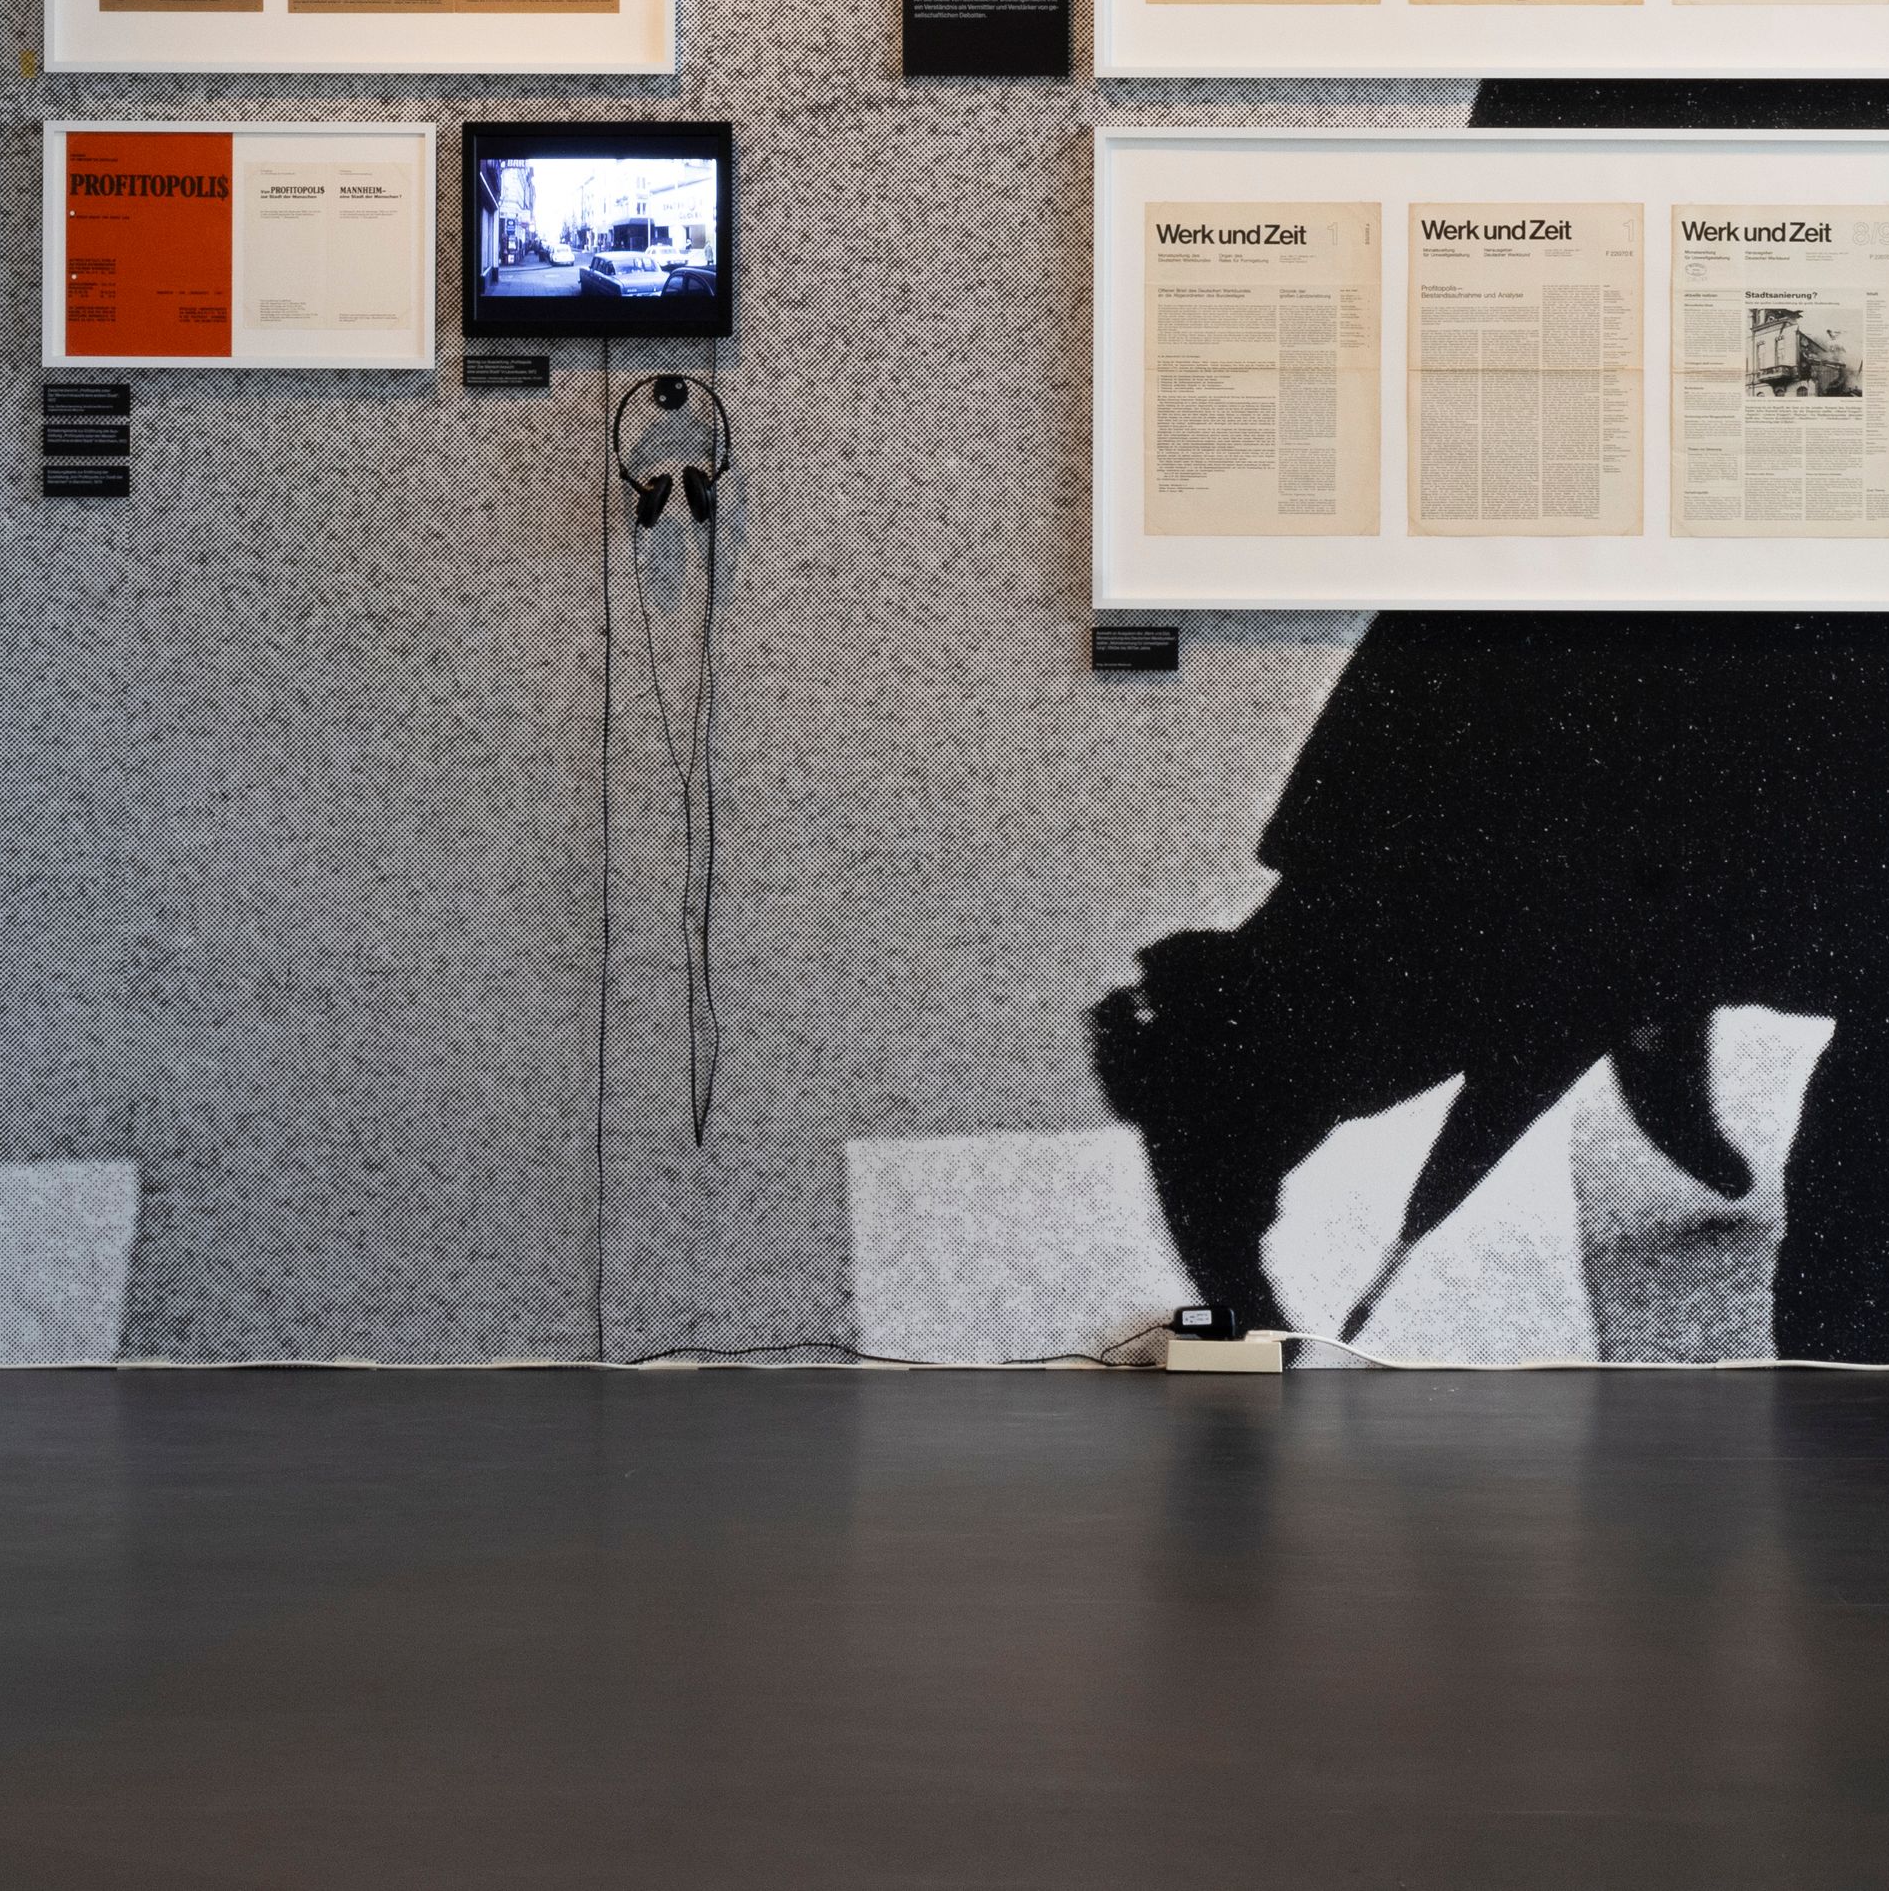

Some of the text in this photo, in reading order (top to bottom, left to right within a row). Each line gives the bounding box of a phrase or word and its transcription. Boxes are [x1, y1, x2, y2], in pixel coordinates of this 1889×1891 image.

[1156, 224, 1215, 245] Werk
[1219, 224, 1260, 245] und
[1264, 224, 1307, 245] Zeit
[1421, 220, 1480, 240] Werk
[1484, 220, 1525, 240] und
[1529, 220, 1572, 240] Zeit
[1681, 221, 1740, 242] Werk
[1744, 222, 1786, 242] und
[1789, 222, 1832, 243] Zeit
[1497, 292, 1524, 300] Analyse
[1745, 291, 1818, 300] Stadtsanierung?
